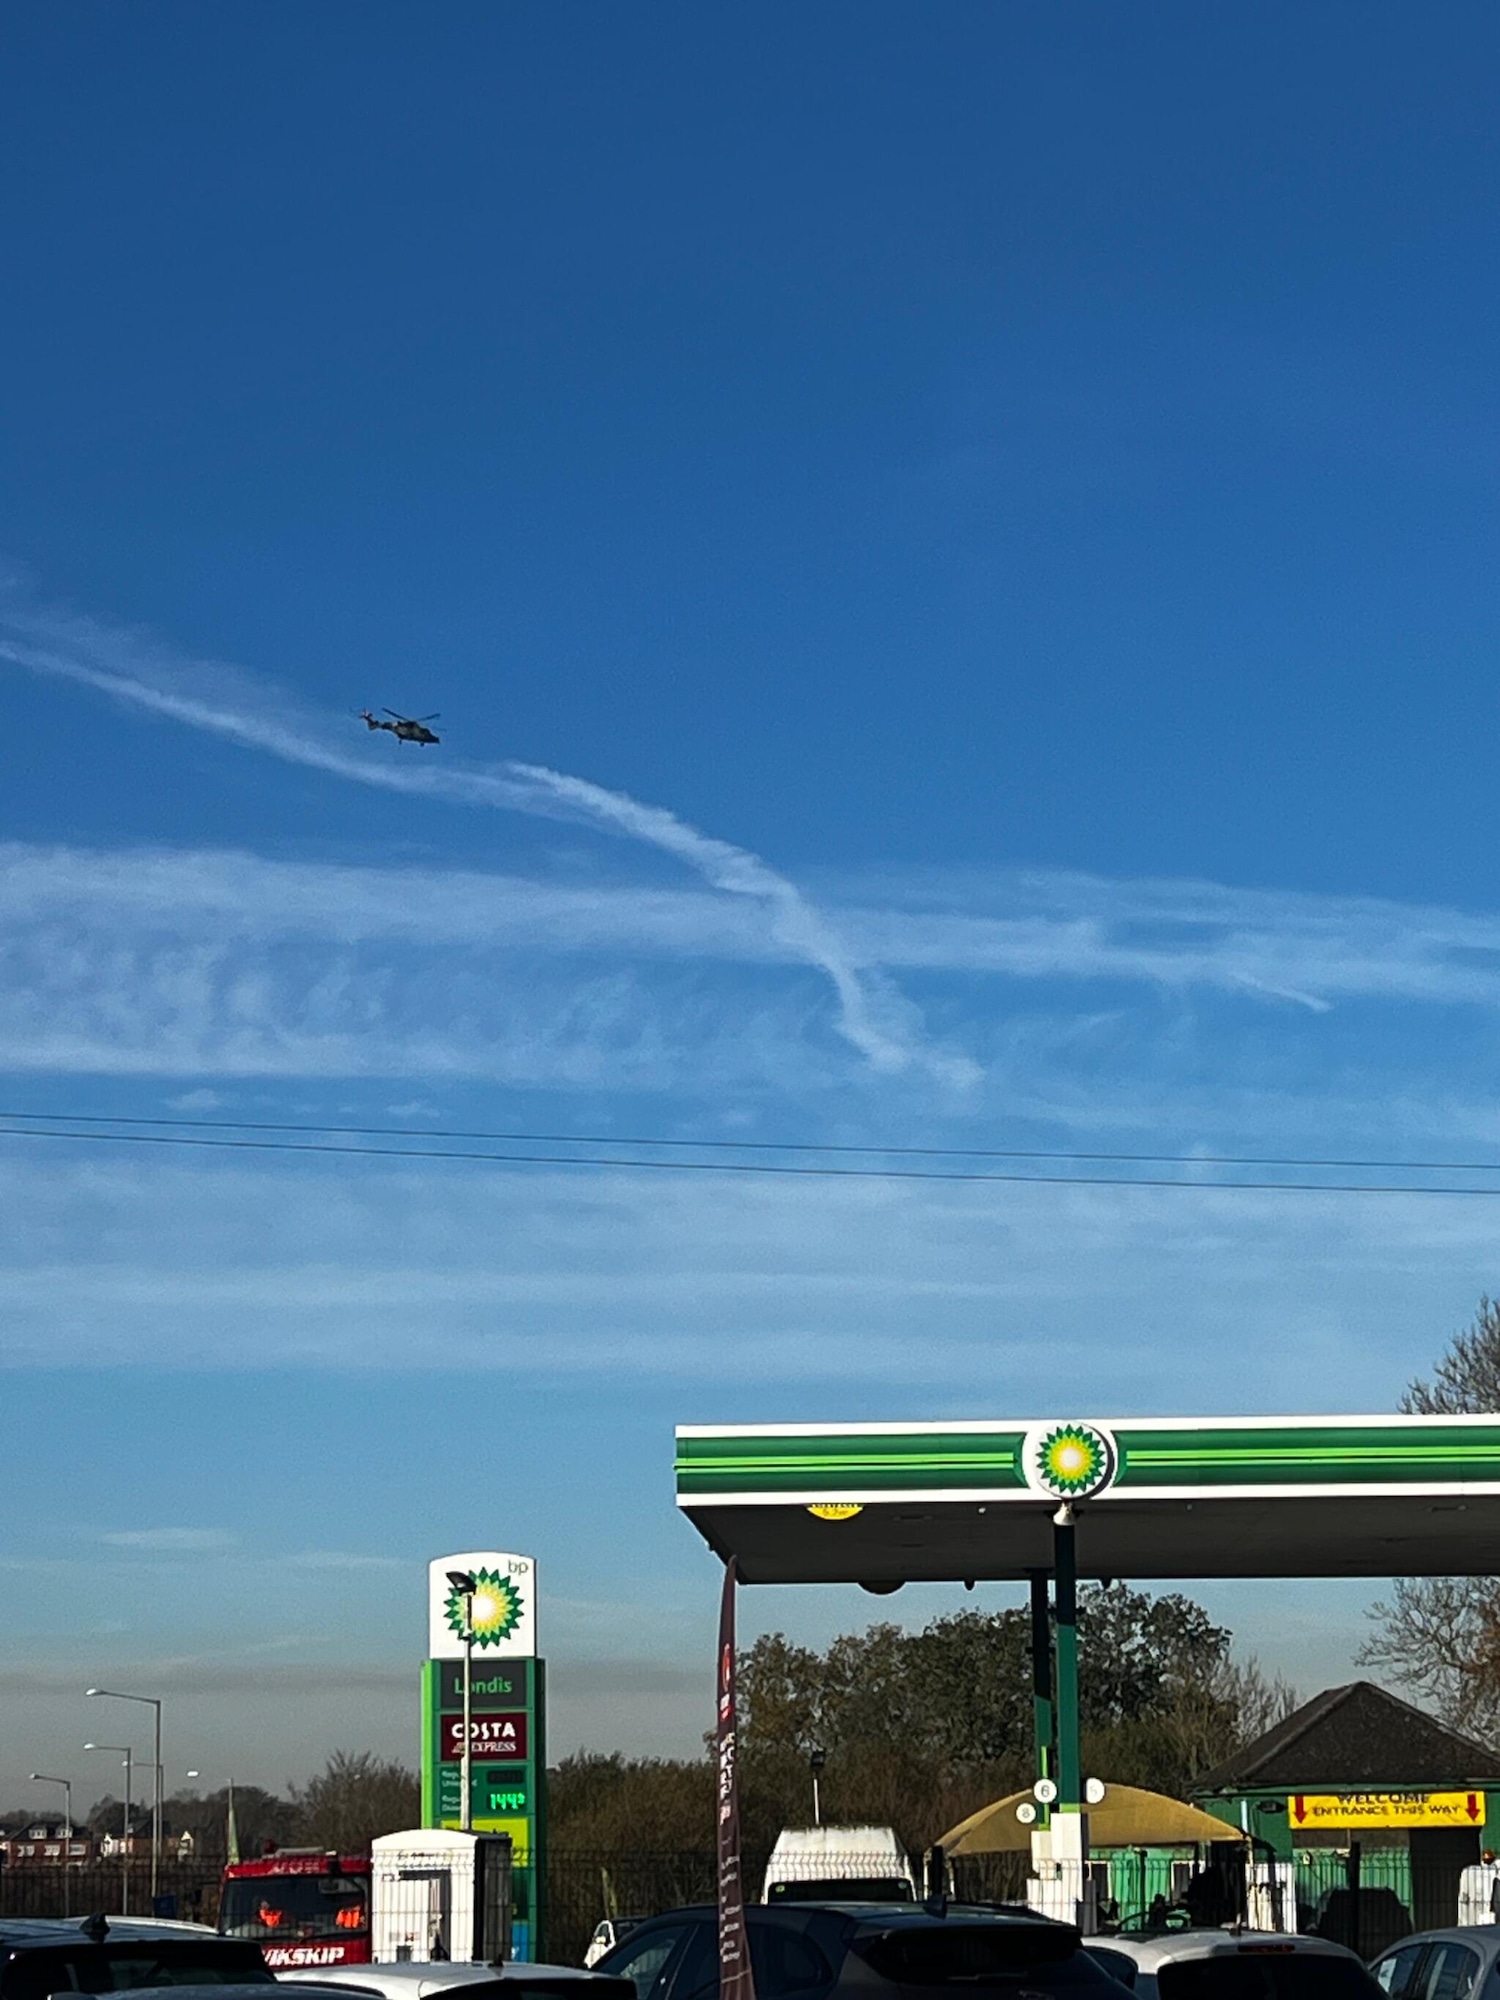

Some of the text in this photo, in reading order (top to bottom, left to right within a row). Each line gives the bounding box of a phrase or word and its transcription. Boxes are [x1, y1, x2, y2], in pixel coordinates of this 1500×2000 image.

[508, 1560, 528, 1575] bp
[451, 1722, 516, 1739] COSTA
[1313, 1804, 1460, 1817] ENTRANCE THIS WAY
